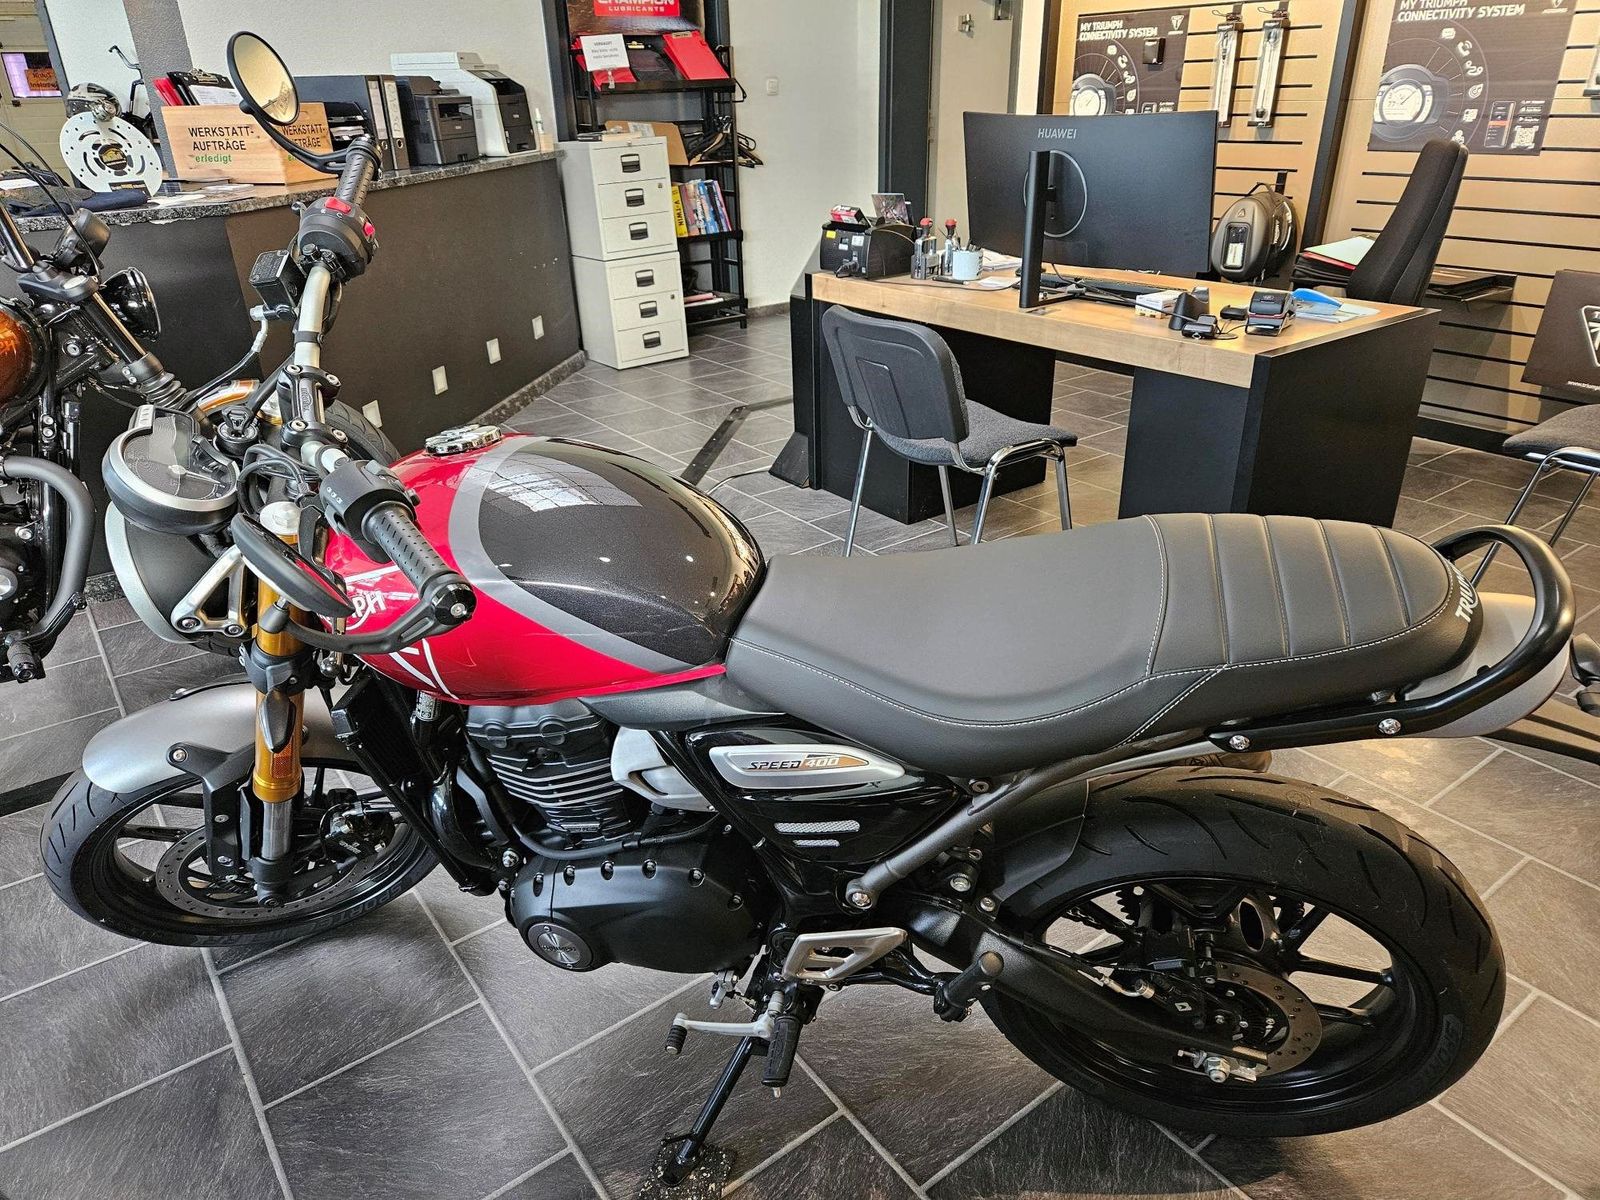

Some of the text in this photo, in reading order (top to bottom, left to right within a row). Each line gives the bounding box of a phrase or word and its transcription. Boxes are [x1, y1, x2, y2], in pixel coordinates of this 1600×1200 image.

[1400, 0, 1468, 10] MY TRIUMPH
[1397, 4, 1526, 22] CONNECTIVITY SYSTEM
[1080, 20, 1124, 32] MY TRIUMPH
[1079, 29, 1128, 41] CONNECTIVITY
[1128, 27, 1159, 38] SYSTEM
[188, 126, 254, 138] WERKSTATT-
[281, 123, 328, 136] WERKSTATT-
[1037, 127, 1078, 139] HUAWEI
[192, 138, 247, 151] AUFTRÄGE
[195, 153, 232, 165] erledigt
[747, 756, 841, 771] SPEED 400
